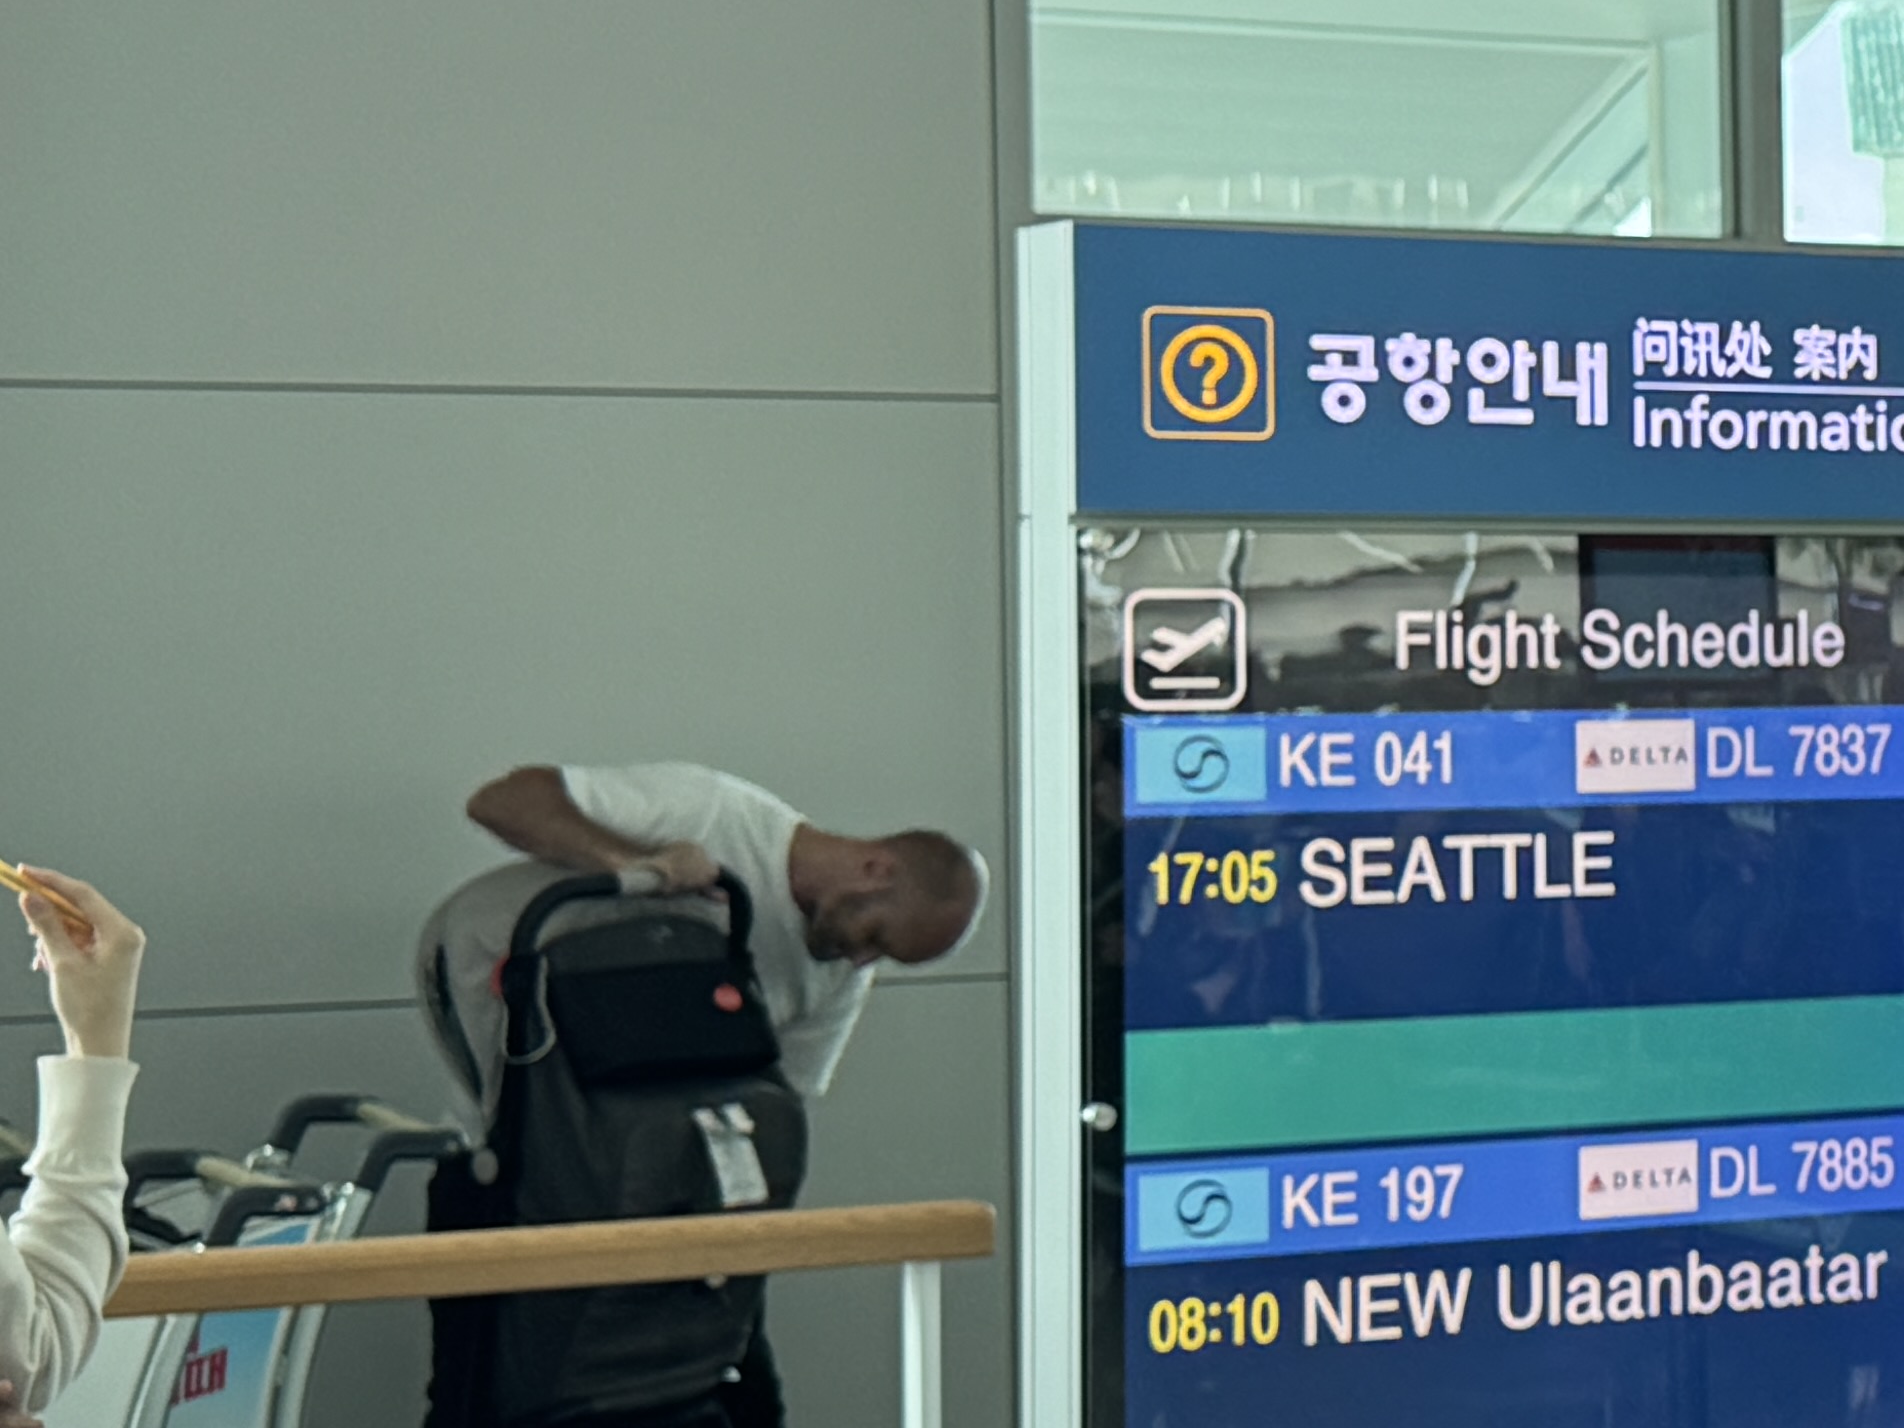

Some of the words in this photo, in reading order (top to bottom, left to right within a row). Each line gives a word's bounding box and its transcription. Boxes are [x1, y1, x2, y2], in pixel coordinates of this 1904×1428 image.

[1307, 331, 1610, 427] 공항안내
[1631, 316, 1772, 381] 问讯处
[1793, 324, 1878, 381] 案内
[1397, 609, 1560, 687] Flight
[1580, 609, 1845, 671] Schedule
[1279, 733, 1355, 787] KE
[1374, 730, 1454, 786] 041
[1610, 745, 1689, 768] DELTA
[1706, 726, 1772, 779] DL
[1789, 724, 1892, 778] 7837
[1149, 849, 1277, 906] 17:05
[1300, 831, 1616, 909] SEATTLE
[1283, 1172, 1358, 1229] KE
[1380, 1165, 1464, 1223] 197
[1607, 1167, 1692, 1193] DELTA
[1710, 1147, 1776, 1200] DL
[1793, 1137, 1895, 1193] 7885
[1149, 1292, 1280, 1354] 08:10
[1304, 1268, 1472, 1347] NEW
[1497, 1246, 1887, 1331] Ulaanbaatar
